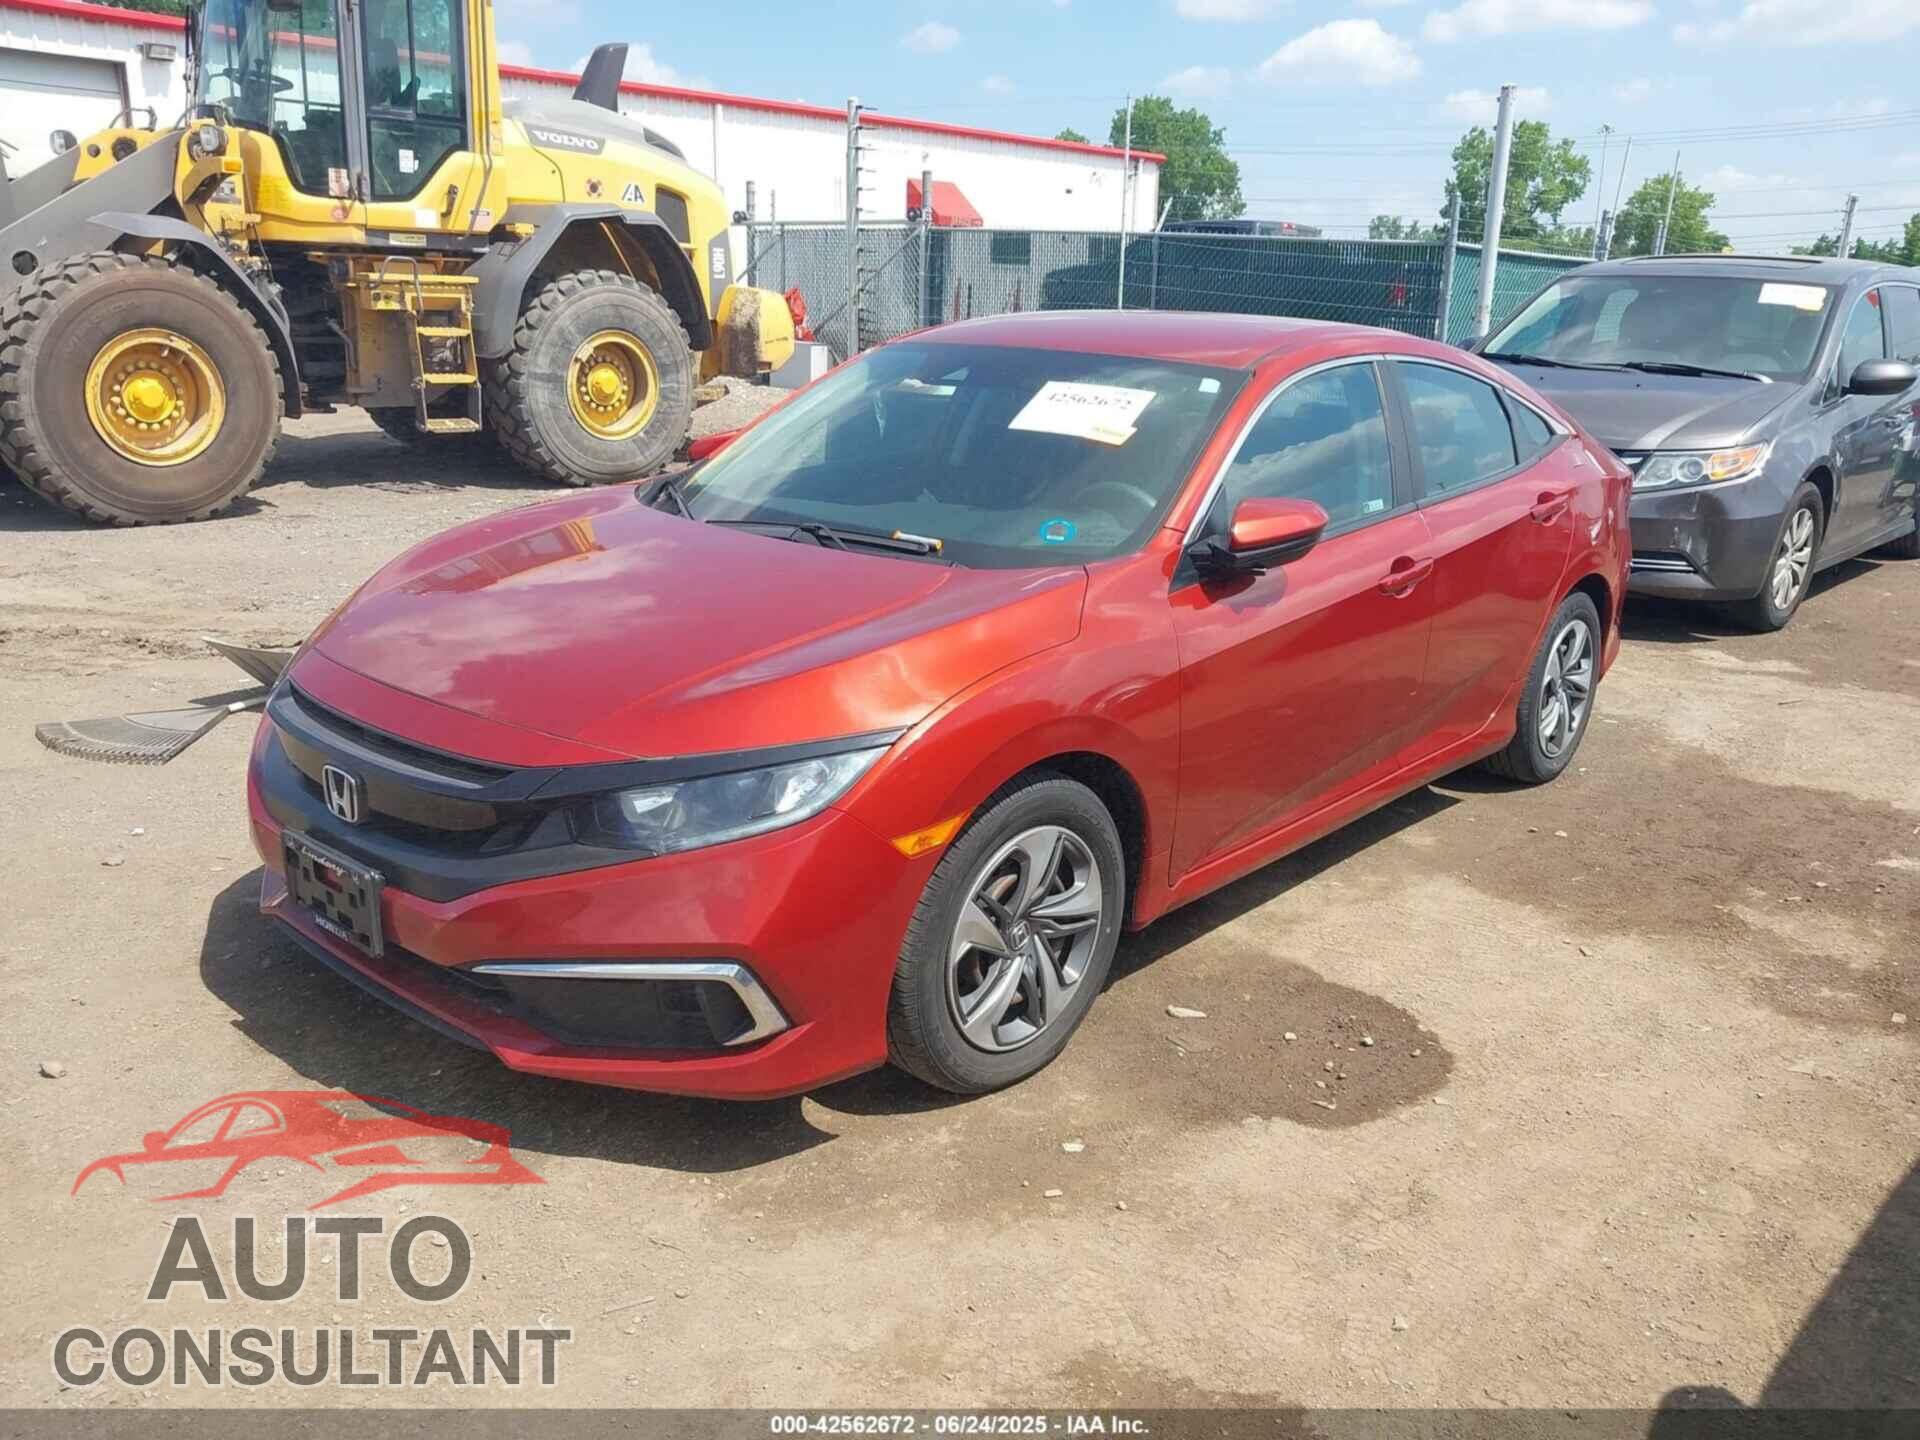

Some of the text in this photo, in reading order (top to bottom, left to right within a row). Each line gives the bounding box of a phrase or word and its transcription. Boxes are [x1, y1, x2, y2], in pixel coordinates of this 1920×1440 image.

[531, 129, 600, 150] VOLVO
[712, 247, 726, 279] L90H
[313, 910, 350, 941] HONDA
